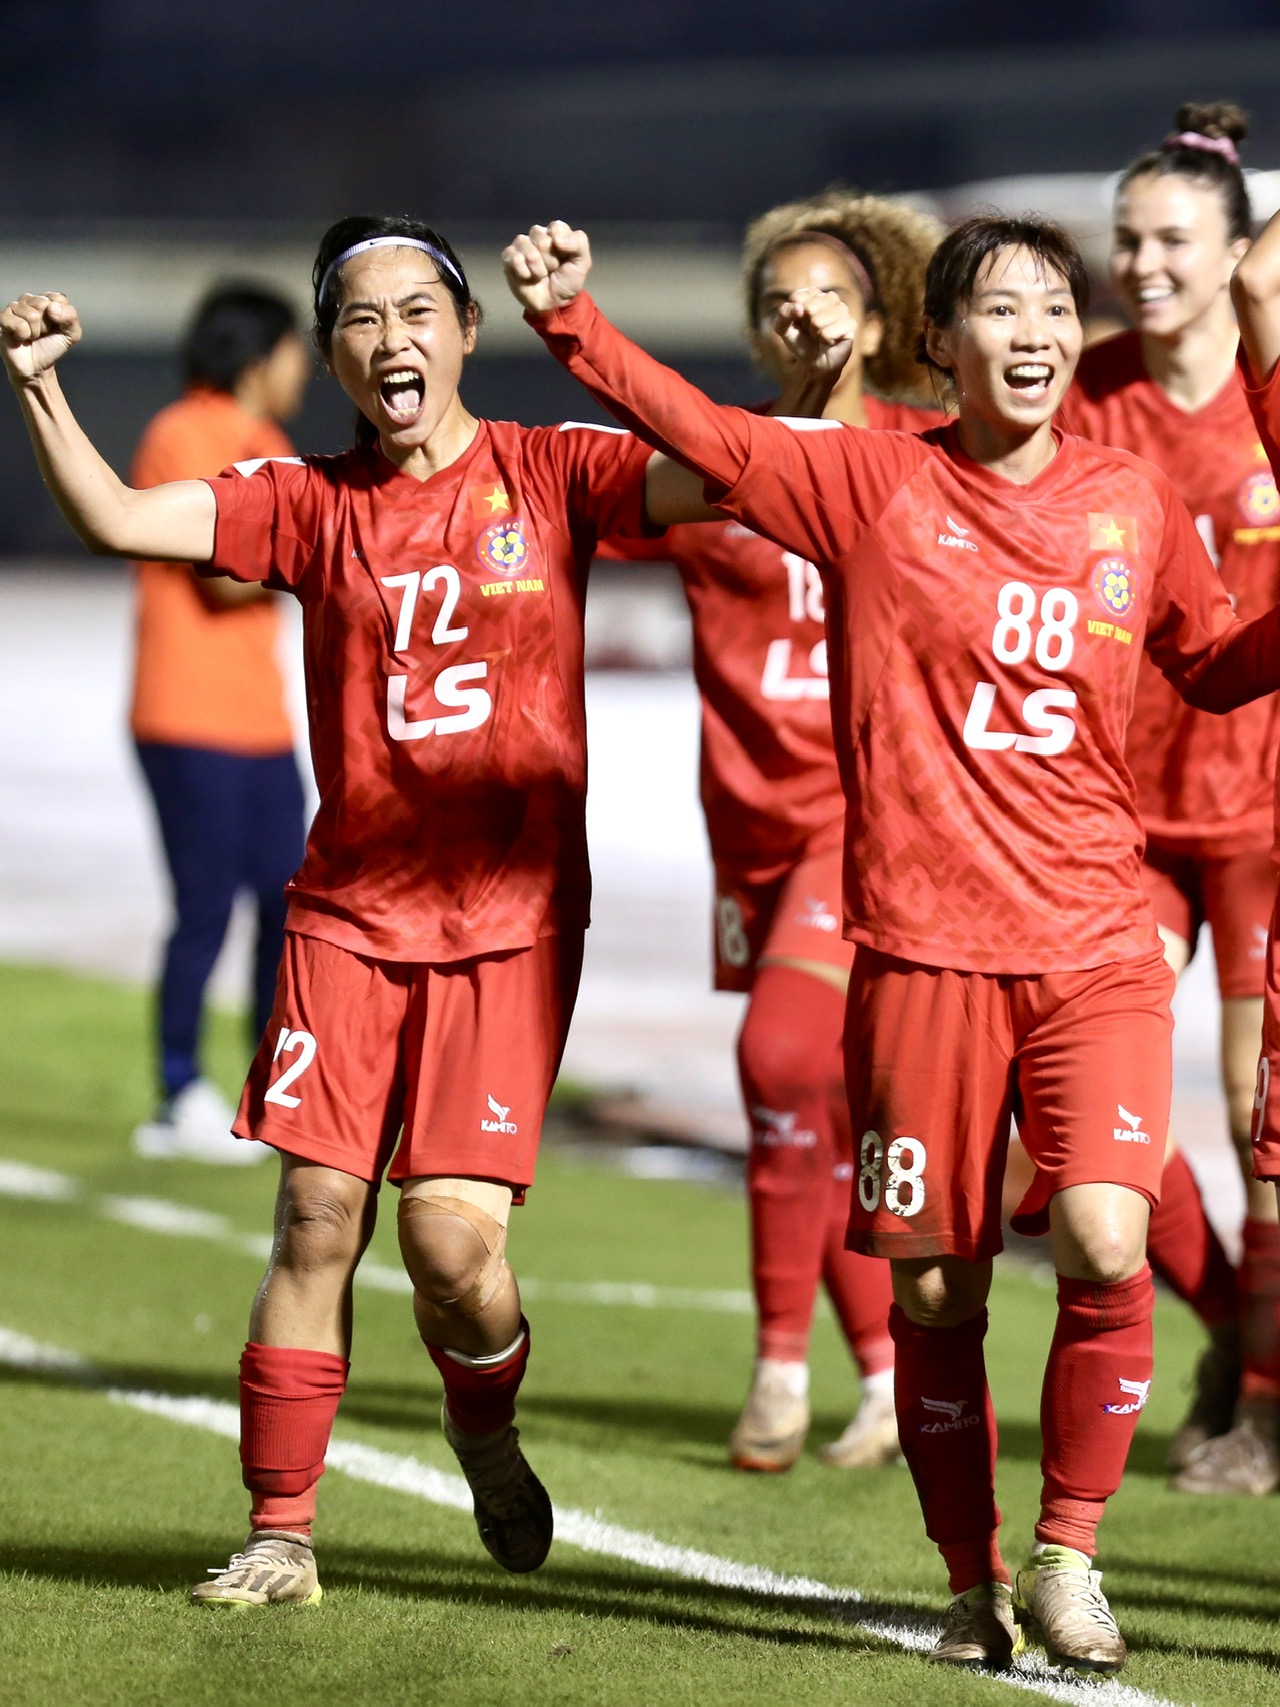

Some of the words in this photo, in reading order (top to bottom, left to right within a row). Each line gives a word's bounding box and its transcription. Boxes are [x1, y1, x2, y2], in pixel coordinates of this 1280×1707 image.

[380, 564, 469, 652] 72
[480, 581, 513, 597] VIET
[515, 578, 545, 593] NAM
[992, 581, 1079, 671] 88
[1087, 619, 1115, 638] VIET
[1113, 625, 1133, 646] NAM
[387, 661, 492, 741] LS
[963, 681, 1077, 757] LS
[481, 1118, 518, 1134] KAMITO
[1112, 1127, 1151, 1145] KAMITO
[1254, 1056, 1270, 1142] 9
[858, 1130, 927, 1217] 88
[918, 1414, 980, 1434] KAMITO
